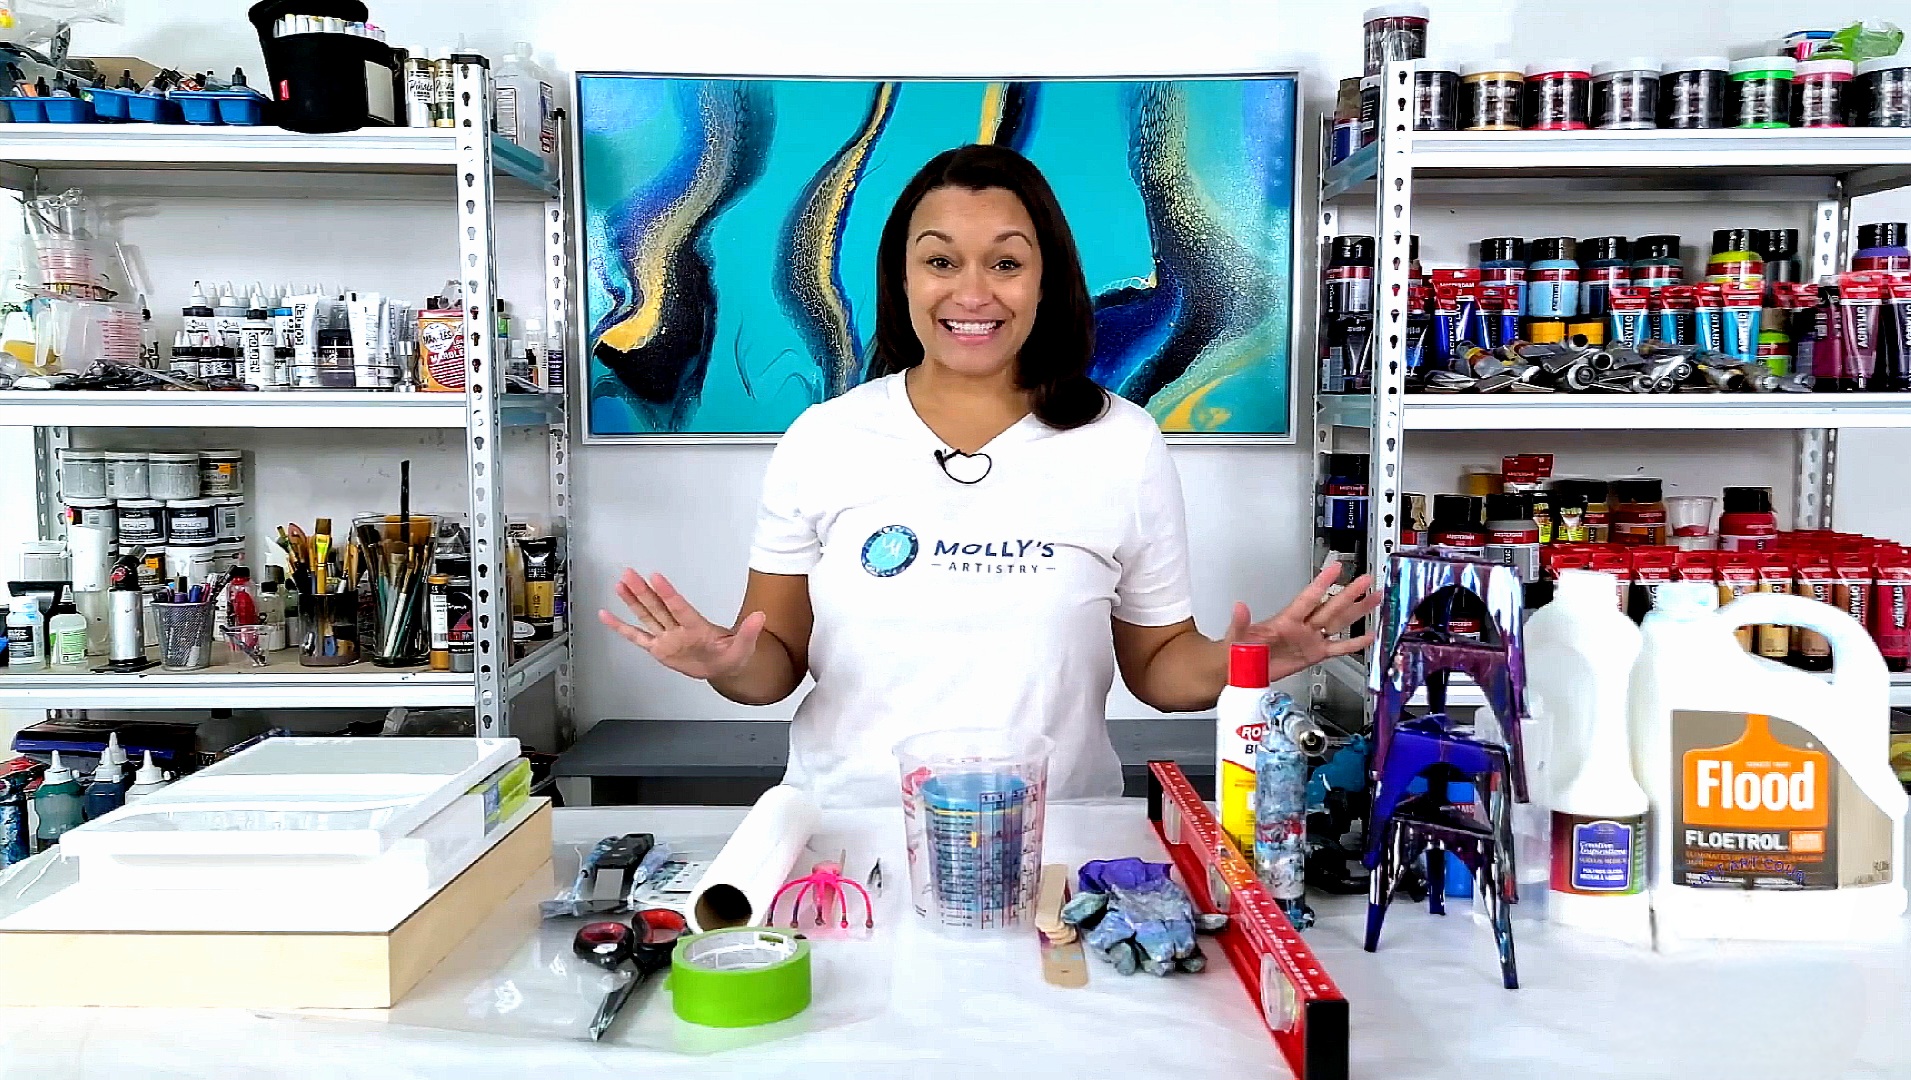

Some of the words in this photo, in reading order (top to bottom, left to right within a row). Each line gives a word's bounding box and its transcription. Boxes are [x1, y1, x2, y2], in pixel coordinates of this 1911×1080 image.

[1624, 315, 1634, 349] CRYLIC
[250, 332, 260, 373] GOLDEN
[933, 539, 1056, 558] MOLLY'S
[948, 562, 1039, 574] ARTISTRY
[1849, 585, 1861, 621] CRYLIC
[1697, 760, 1815, 812] Flood
[1685, 829, 1789, 851] FLOETROL
